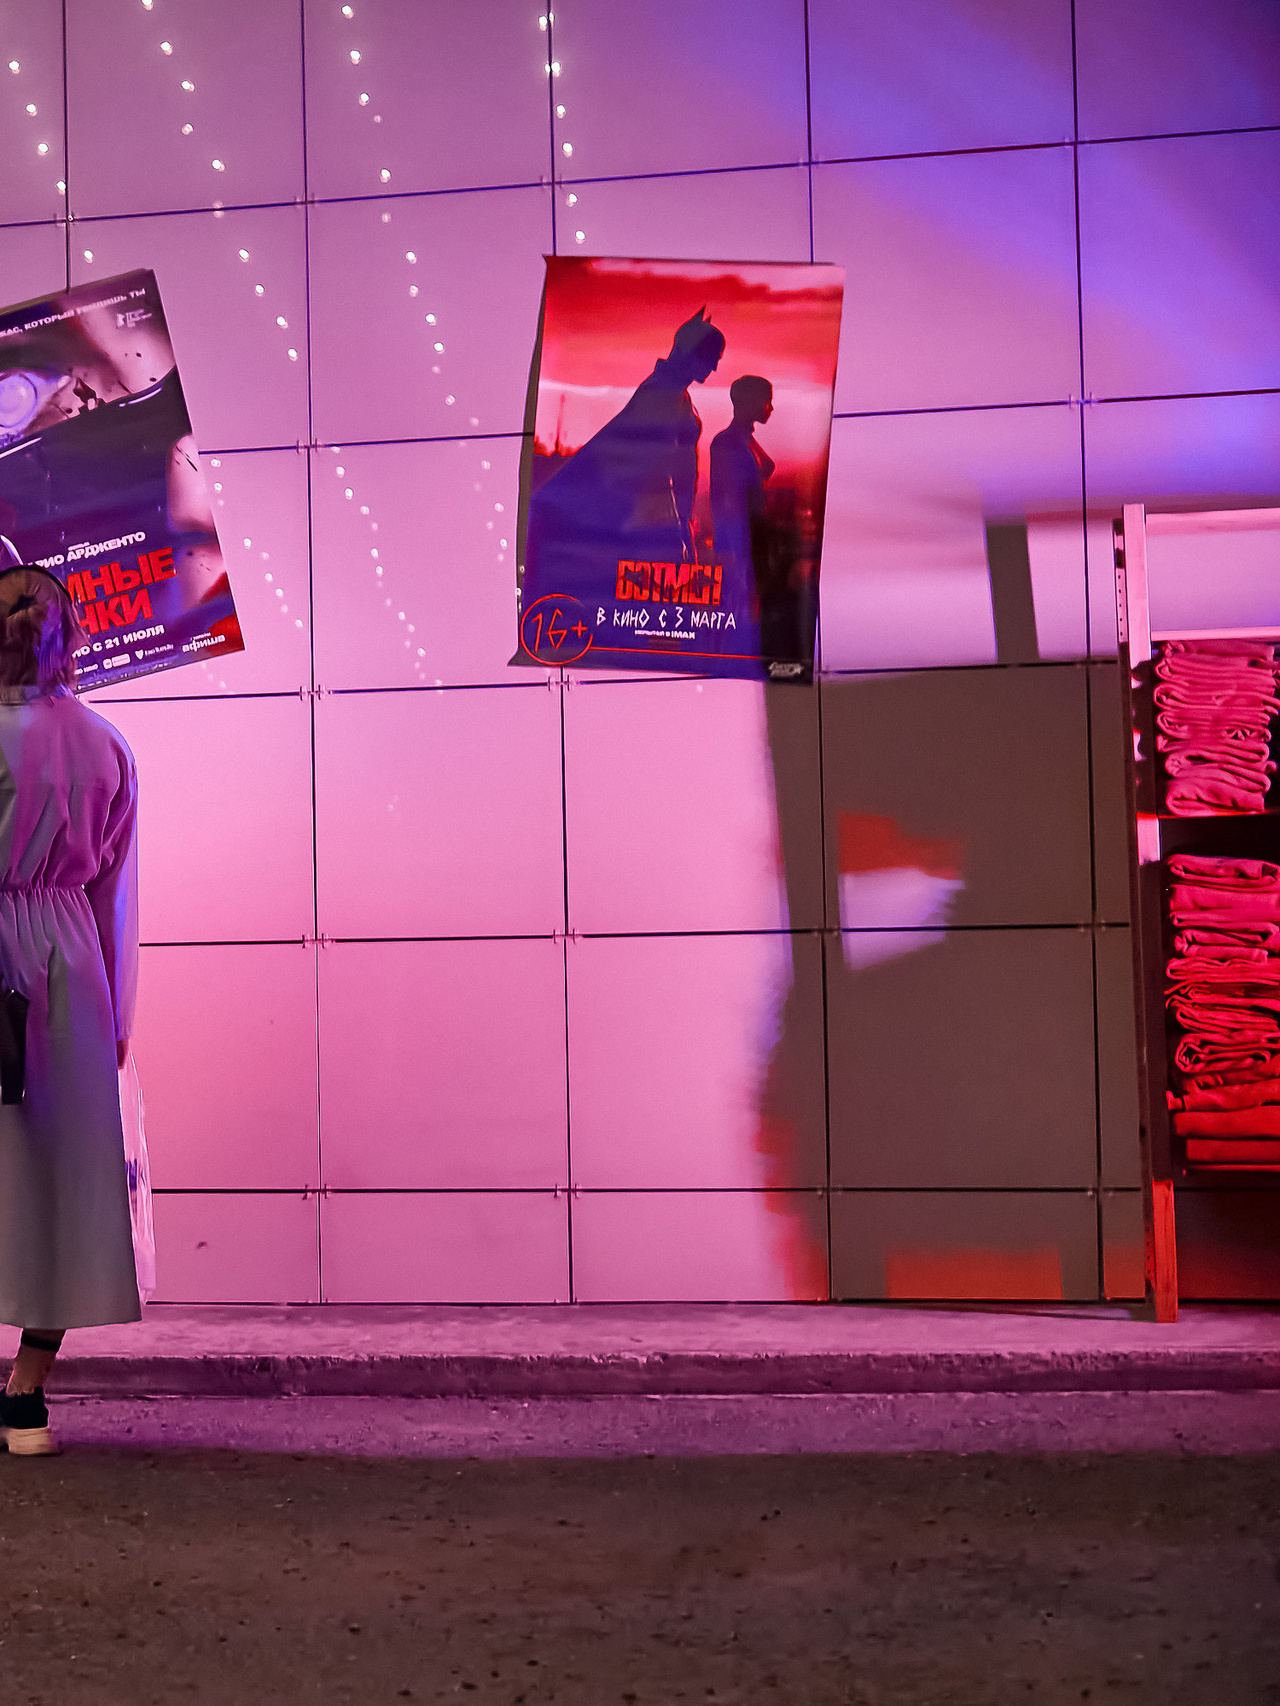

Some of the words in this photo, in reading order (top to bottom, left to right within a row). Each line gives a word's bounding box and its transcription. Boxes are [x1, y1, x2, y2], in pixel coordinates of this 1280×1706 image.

[67, 531, 146, 562] АРДЖЕНТО
[79, 588, 154, 636] ЧКИ
[596, 607, 606, 627] В
[613, 607, 650, 628] КИНО
[658, 608, 668, 628] С
[674, 606, 684, 628] 3
[690, 609, 737, 631] МАРТА
[92, 642, 103, 652] С
[104, 636, 121, 651] 21
[123, 624, 165, 645] ИЮЛЯ
[671, 630, 696, 640] IMAX
